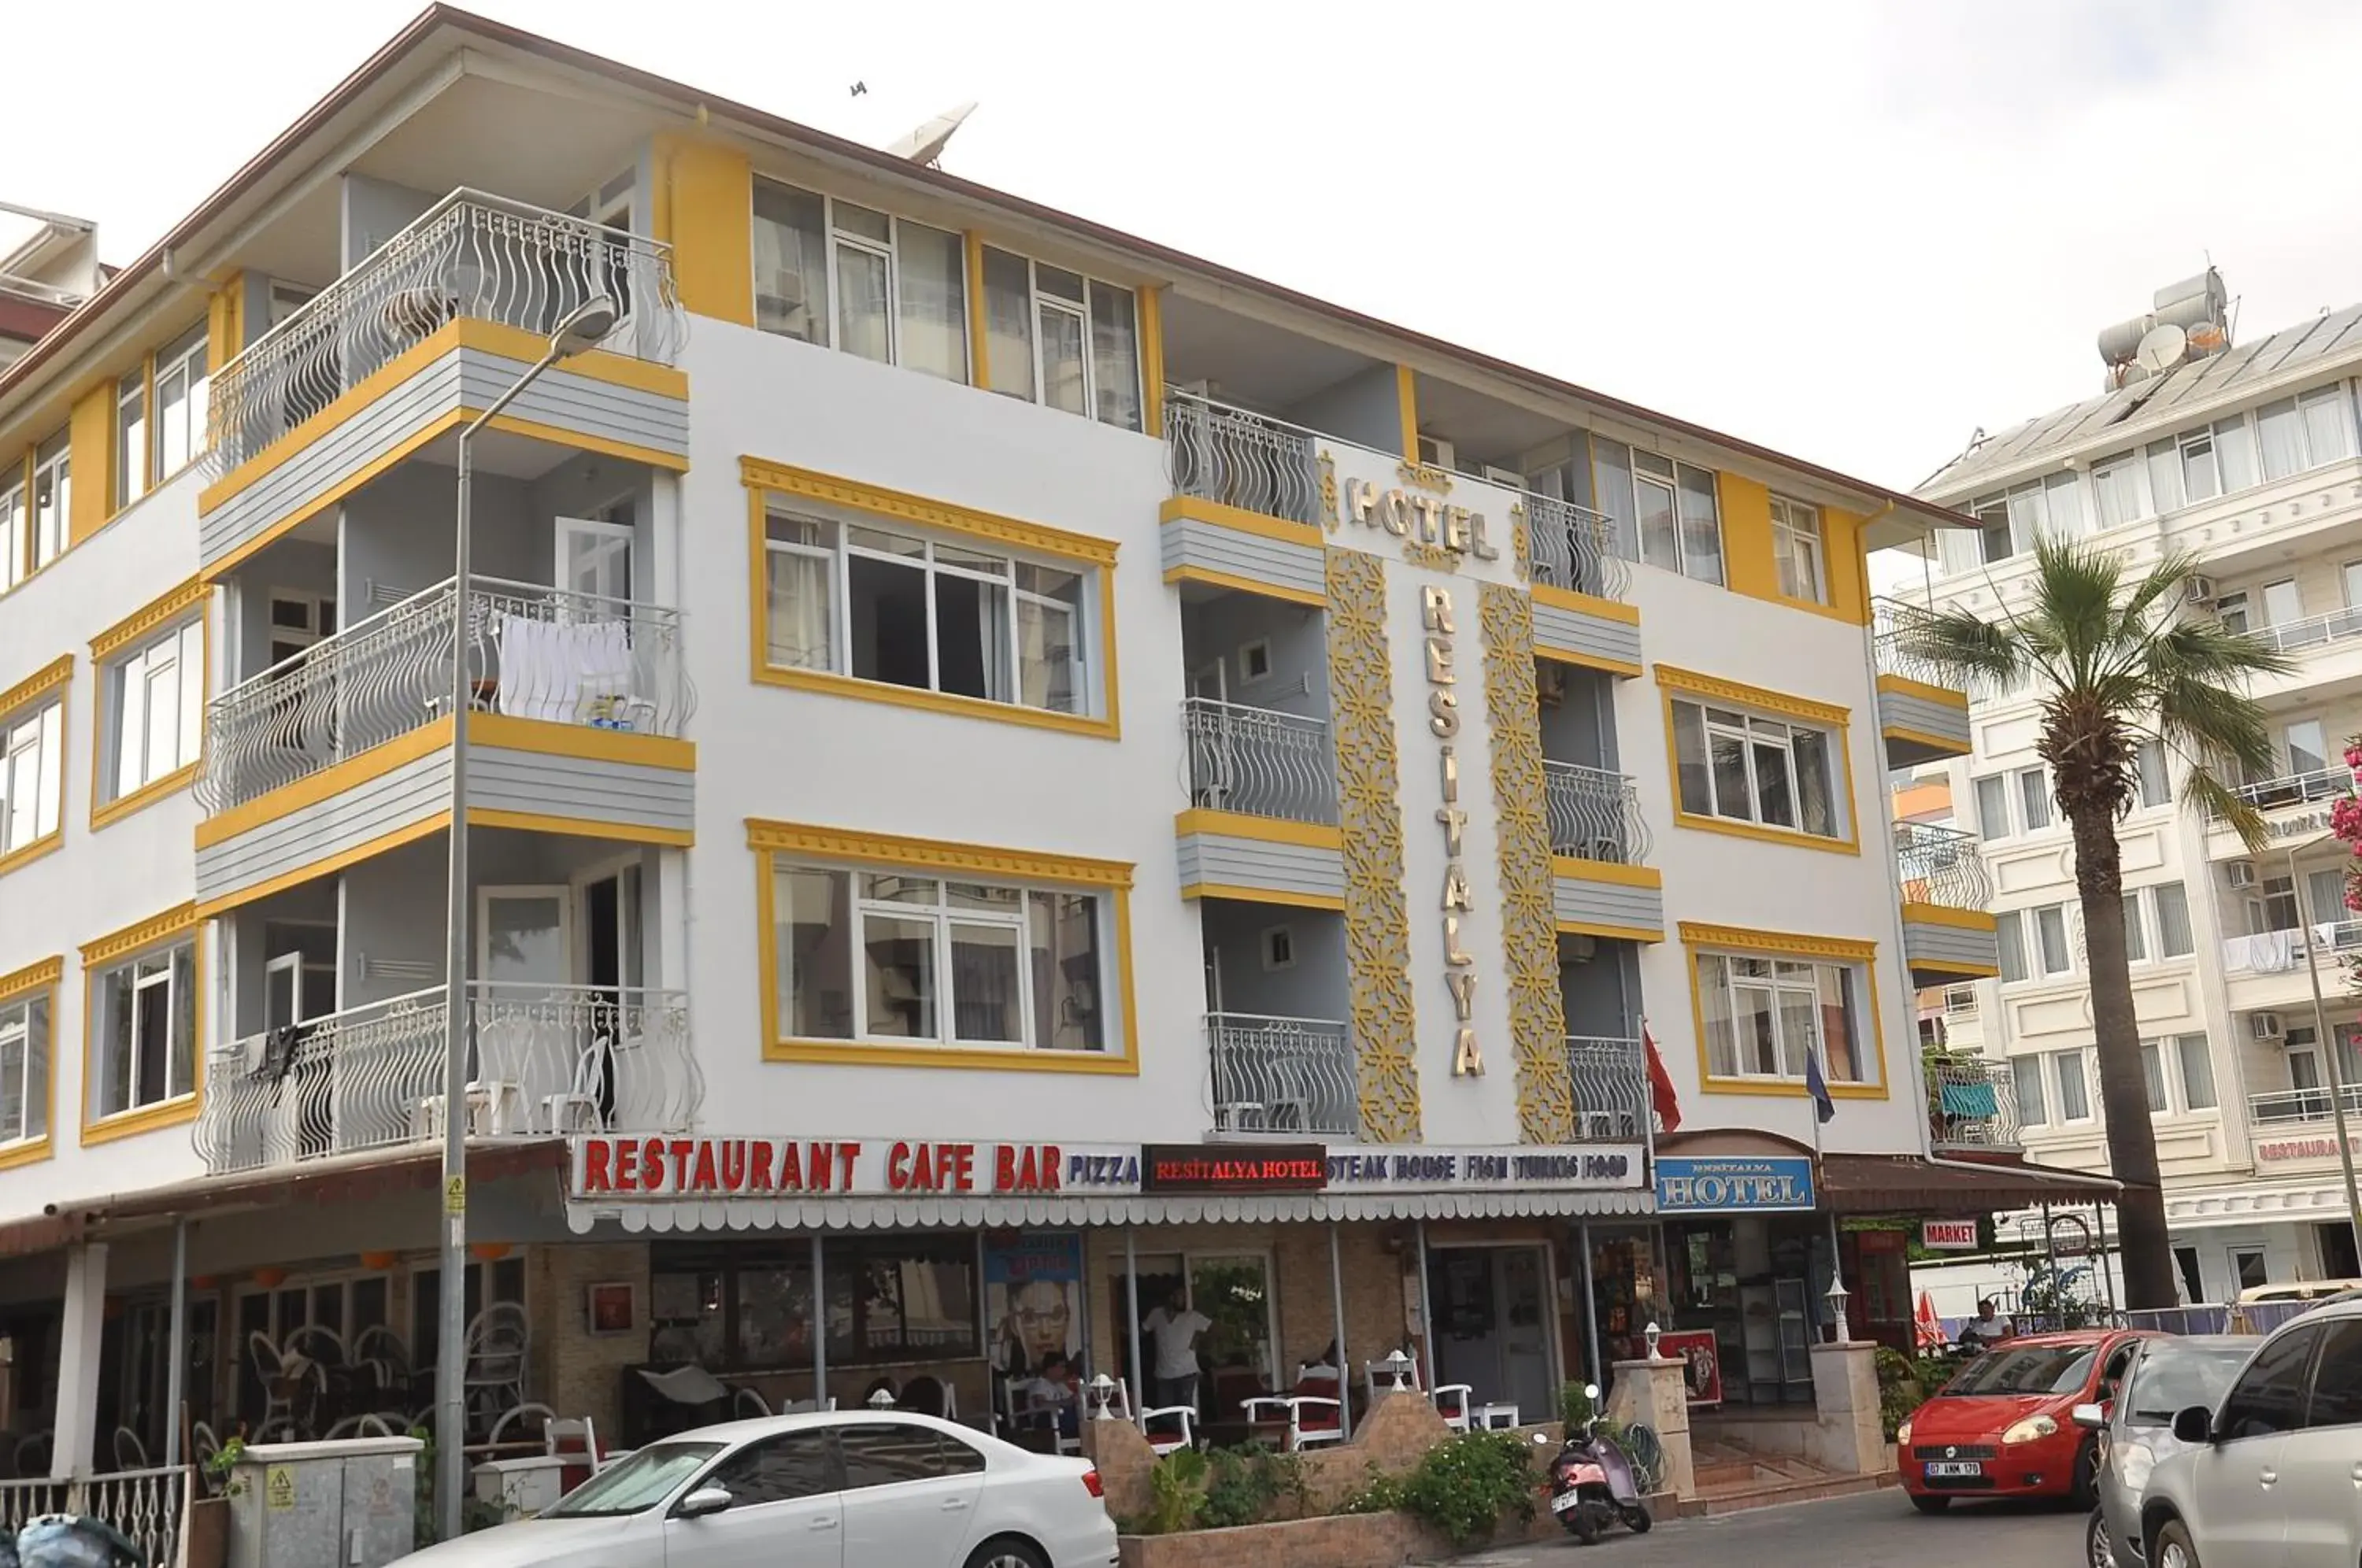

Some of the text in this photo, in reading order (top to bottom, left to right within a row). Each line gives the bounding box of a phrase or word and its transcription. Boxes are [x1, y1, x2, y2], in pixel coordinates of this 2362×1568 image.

[1346, 476, 1499, 561] HOTEL
[2258, 1137, 2360, 1160] RESTAURAT
[583, 1139, 1139, 1193] RESTAURANT CAFE BAR PIZZA
[1261, 1160, 1322, 1178] HOTEL
[1326, 1155, 1389, 1182] STEAK
[1392, 1155, 1456, 1182] HOUSE
[1463, 1155, 1508, 1181] FISH
[1581, 1154, 1628, 1180] FOOD
[1660, 1175, 1805, 1206] HOTEL
[1926, 1225, 1974, 1243] MARKET
